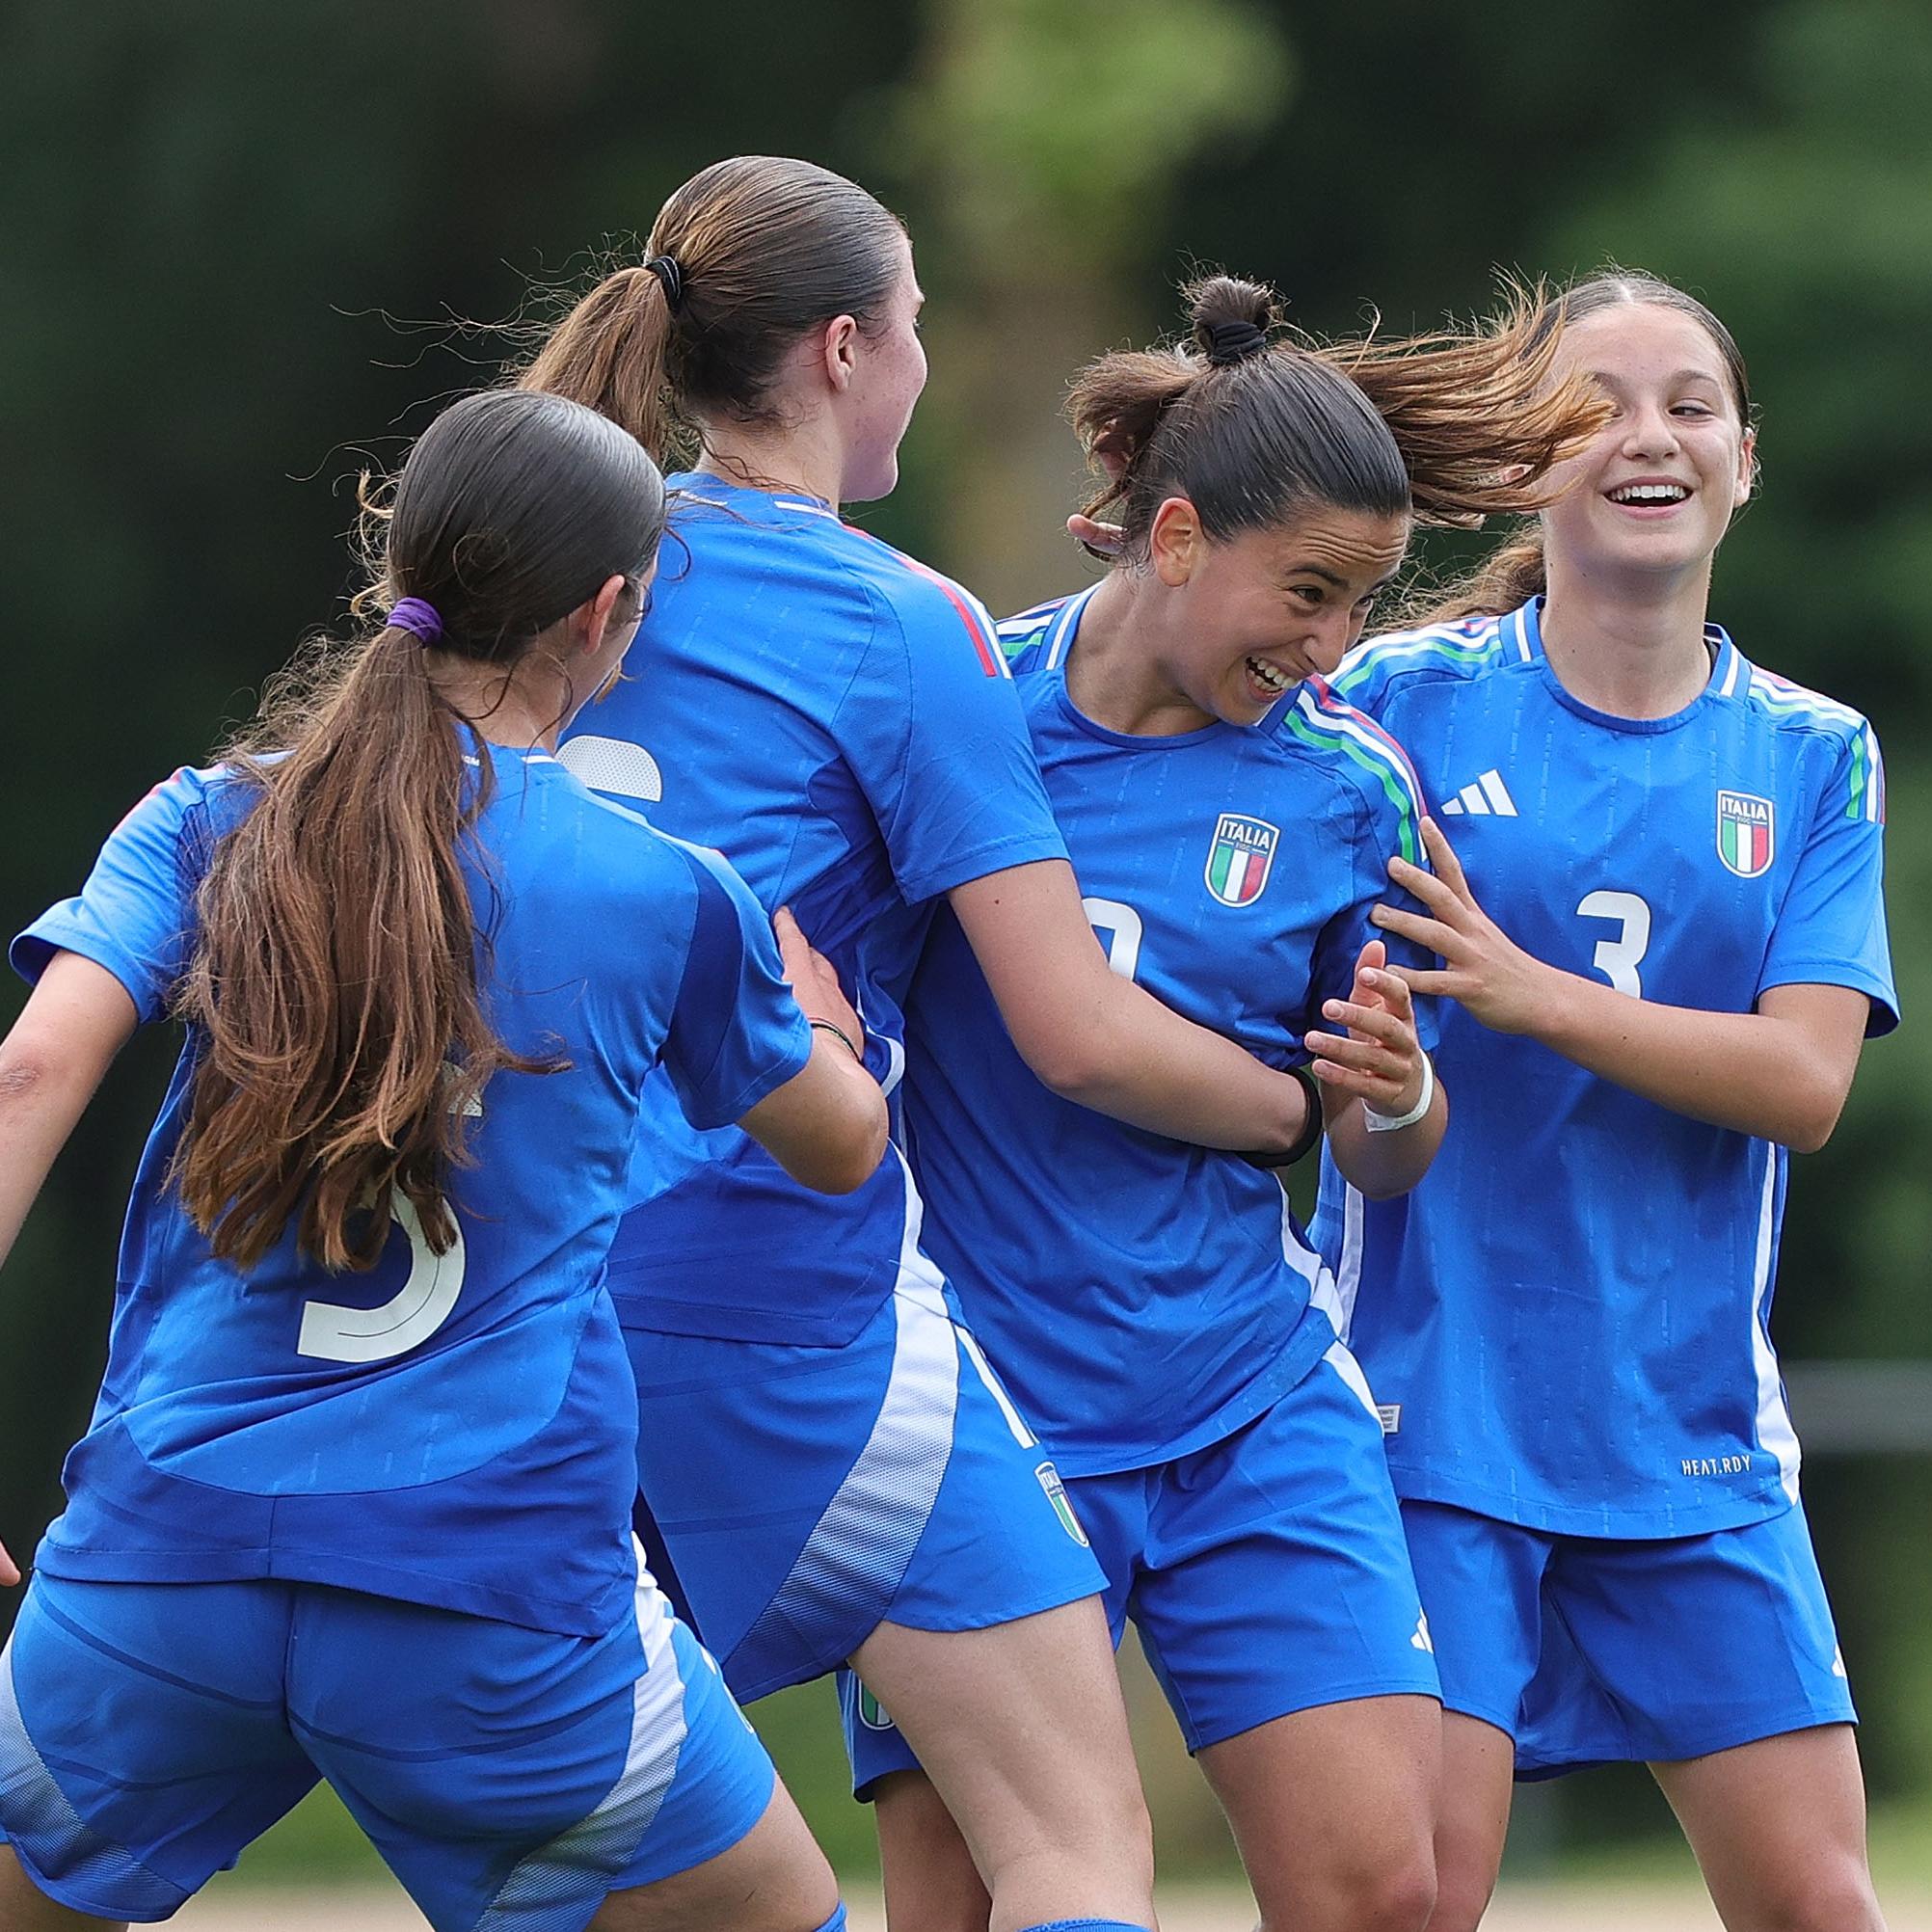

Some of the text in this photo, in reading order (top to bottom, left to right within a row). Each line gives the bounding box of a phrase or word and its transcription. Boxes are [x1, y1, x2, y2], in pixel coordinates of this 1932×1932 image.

[1721, 795, 1768, 821] ITALIA
[1220, 819, 1270, 849] ITALIA
[1576, 889, 1650, 1001] 3
[1681, 1455, 1752, 1476] HEAT.RDY
